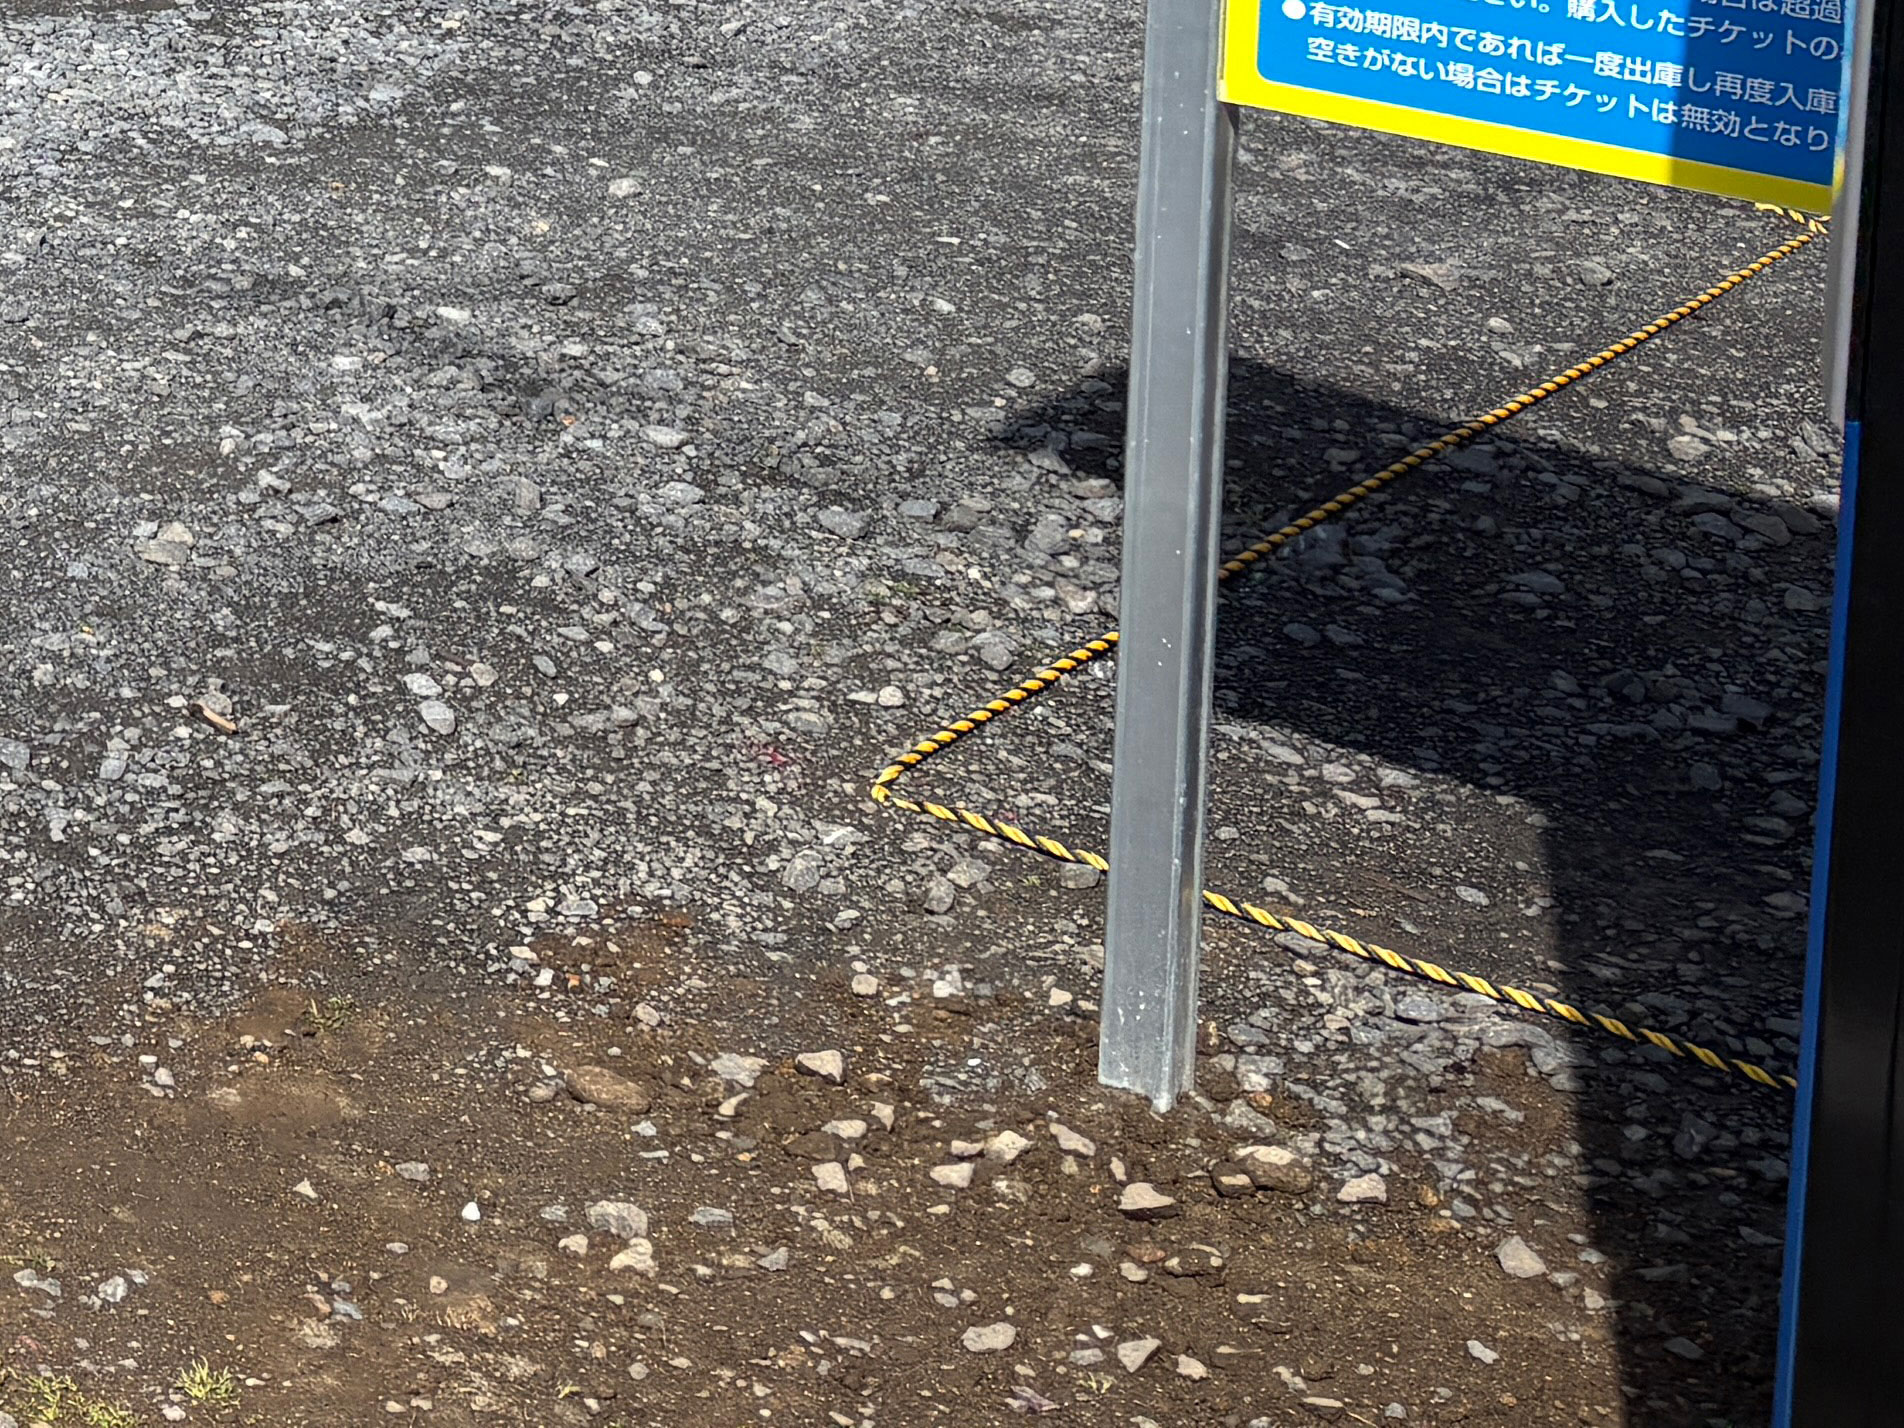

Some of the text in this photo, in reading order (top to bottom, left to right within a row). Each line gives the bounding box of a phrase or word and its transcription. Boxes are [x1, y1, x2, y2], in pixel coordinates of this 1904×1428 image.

[1306, 36, 1830, 152] 空きがない場合はチケットは無効となり
[1308, 1, 1838, 116] 有効期限内であれば一度出庫し再度入庫
